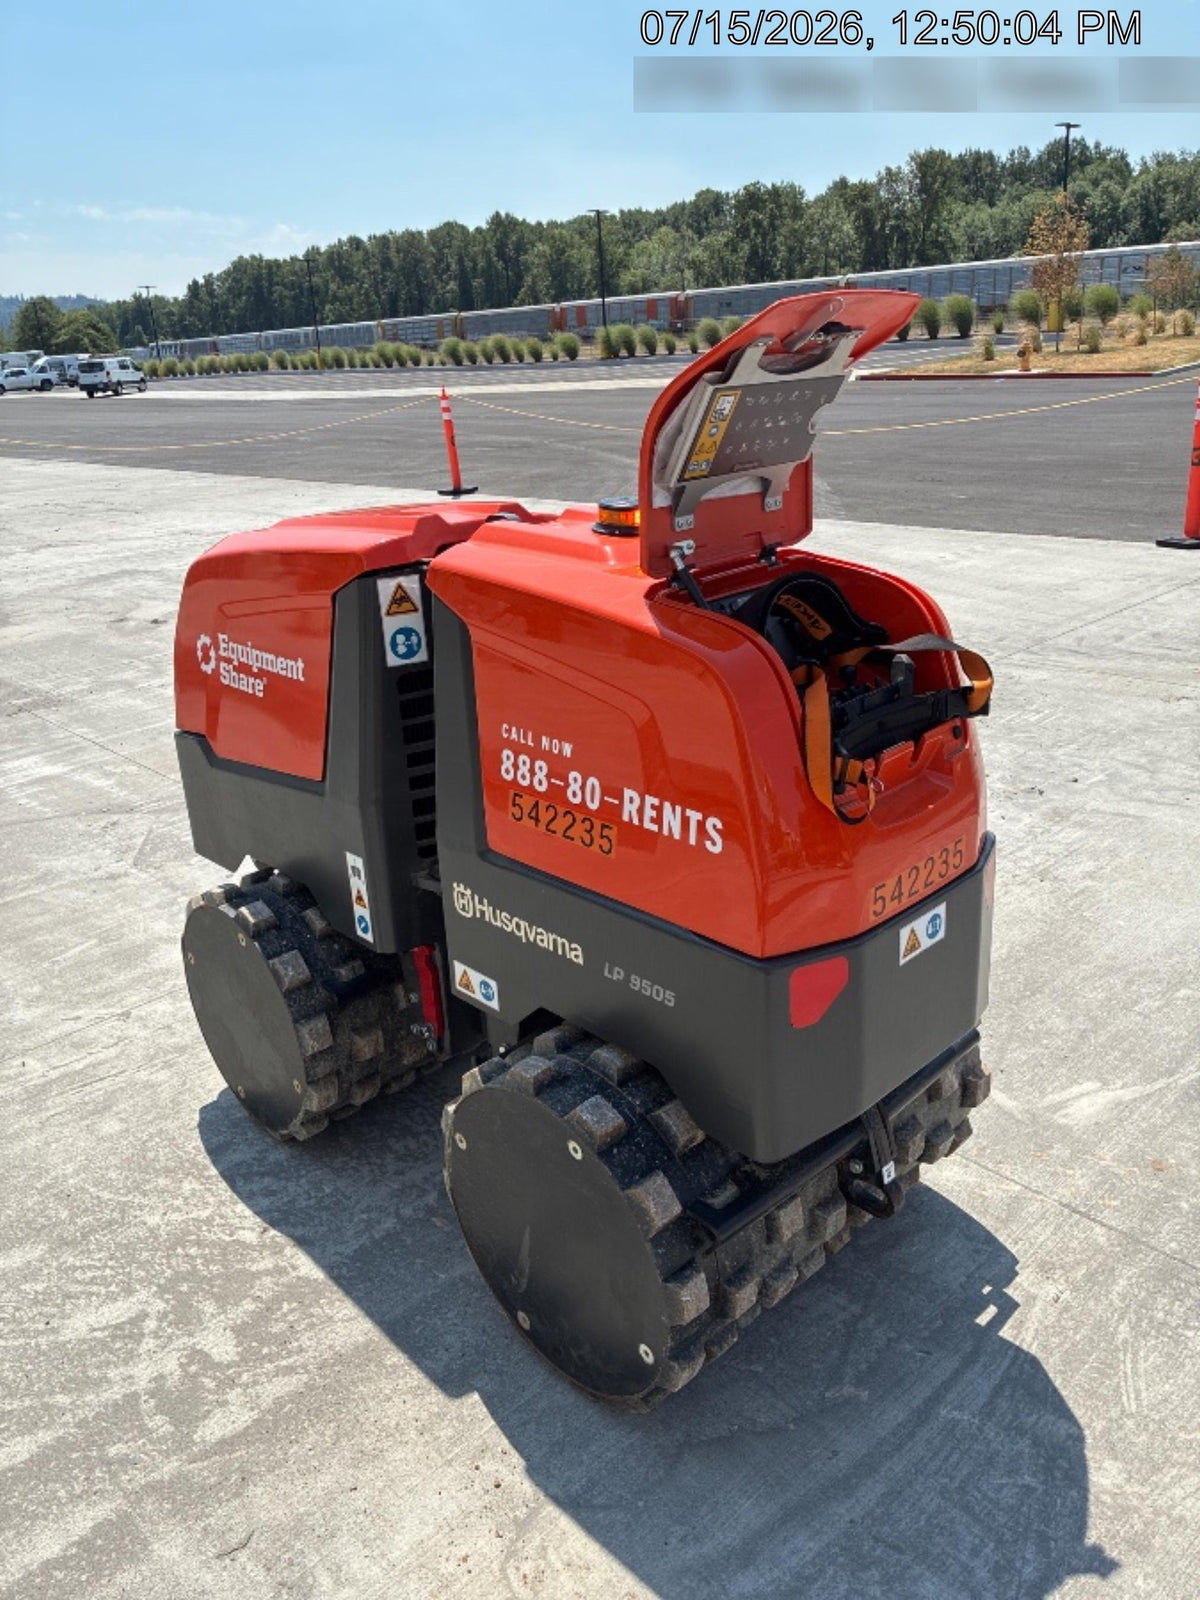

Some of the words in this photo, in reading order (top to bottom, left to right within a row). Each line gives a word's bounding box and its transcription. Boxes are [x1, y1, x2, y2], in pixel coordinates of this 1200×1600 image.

[218, 634, 304, 682] Equipment
[501, 723, 535, 747] CALL
[541, 735, 574, 758] NOW
[500, 748, 724, 854] 888-80-RENTS
[511, 792, 614, 856] 542235
[872, 838, 965, 917] 542235
[475, 894, 584, 965] Husqvarna
[603, 962, 625, 982] LP
[629, 975, 677, 1008] 9505
